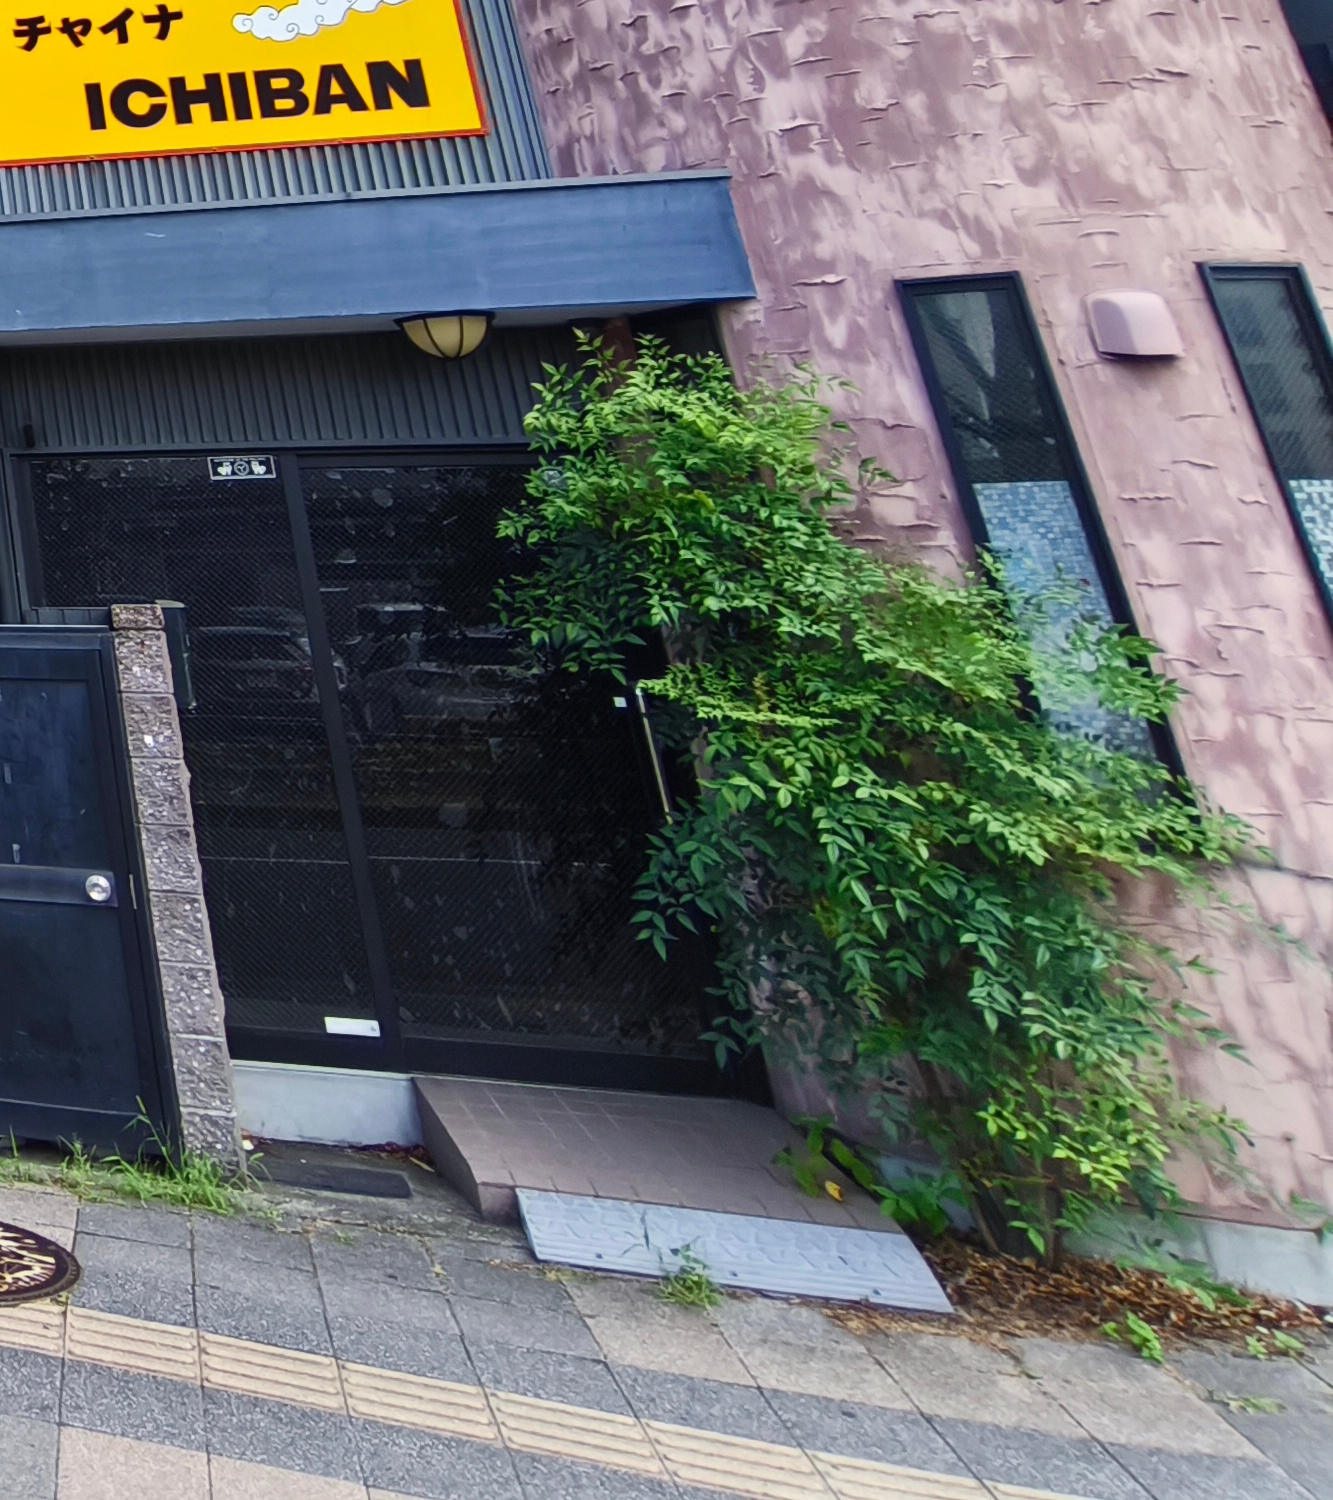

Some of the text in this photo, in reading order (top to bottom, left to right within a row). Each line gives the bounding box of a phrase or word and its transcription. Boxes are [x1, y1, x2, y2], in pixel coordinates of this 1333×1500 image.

[11, 3, 184, 52] チャイナ
[83, 58, 430, 131] ICHIBAN
